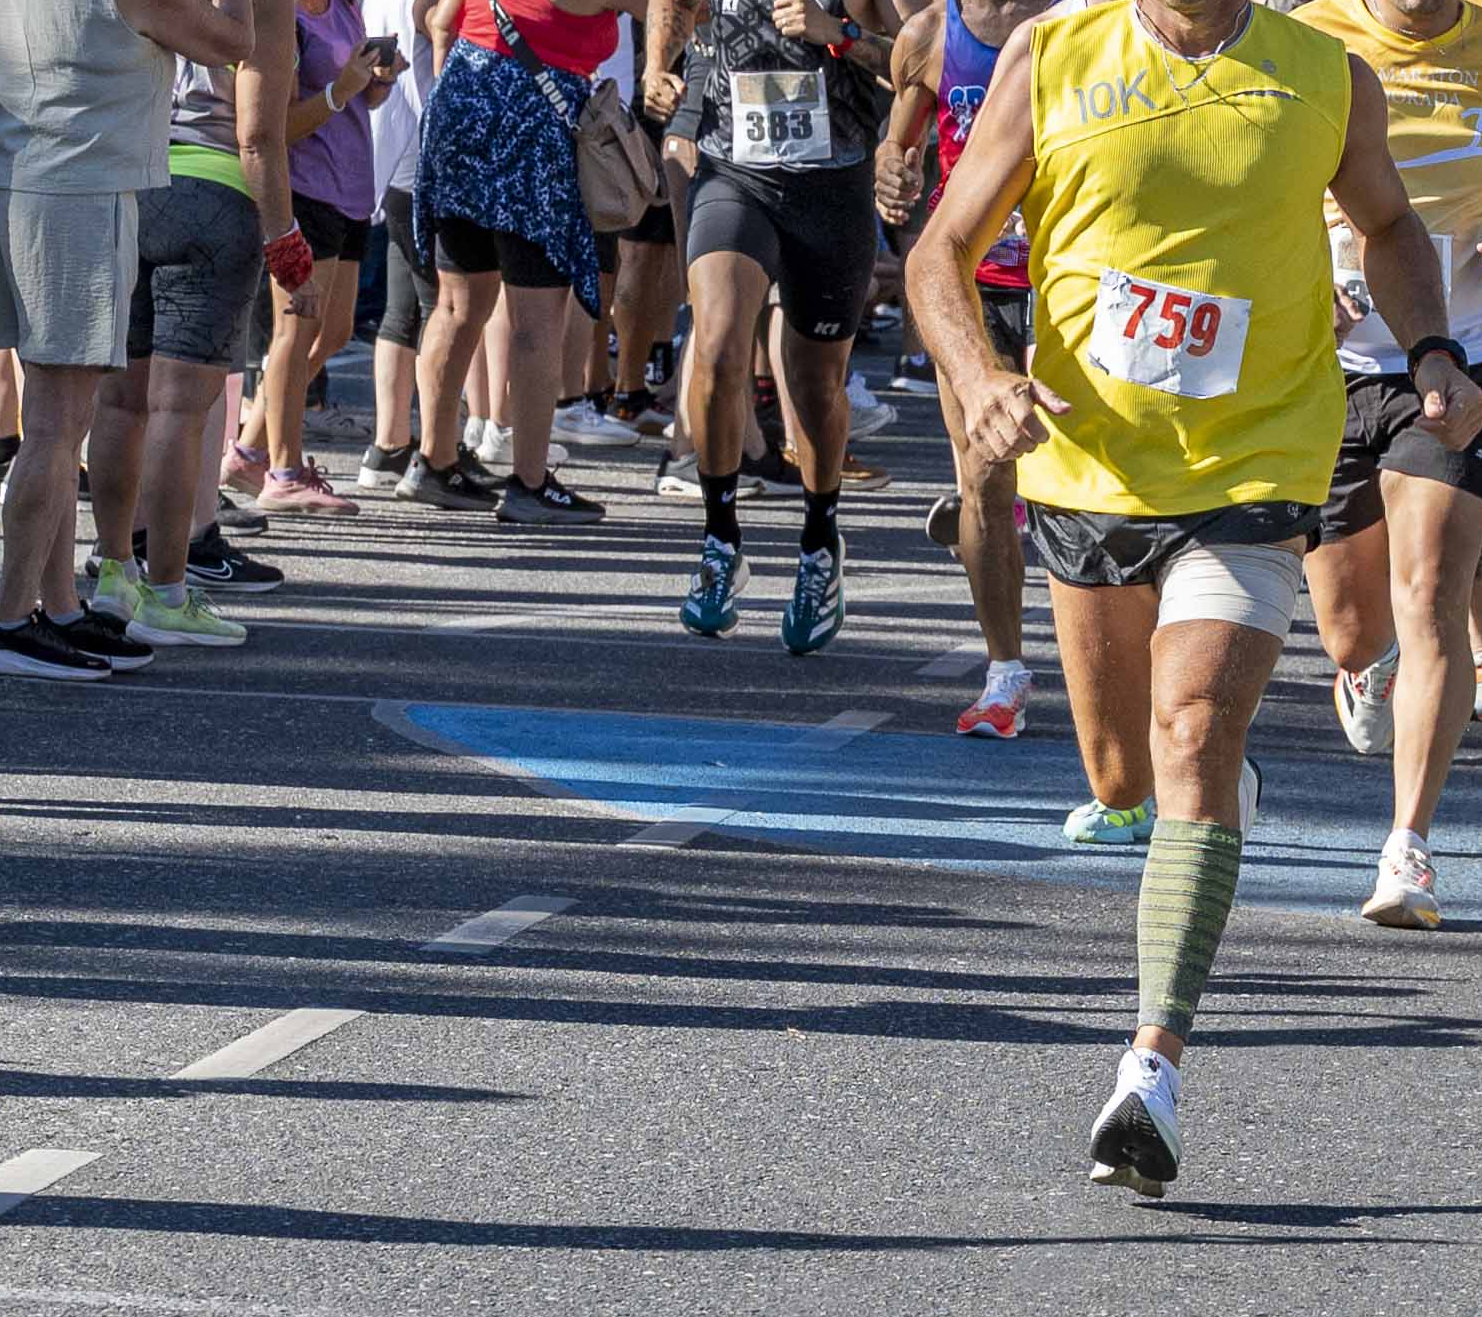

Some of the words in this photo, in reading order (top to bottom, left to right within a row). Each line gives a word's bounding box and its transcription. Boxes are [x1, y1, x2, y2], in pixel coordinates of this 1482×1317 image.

[1074, 69, 1158, 124] 10K
[746, 109, 814, 142] 383
[1122, 283, 1222, 358] 759
